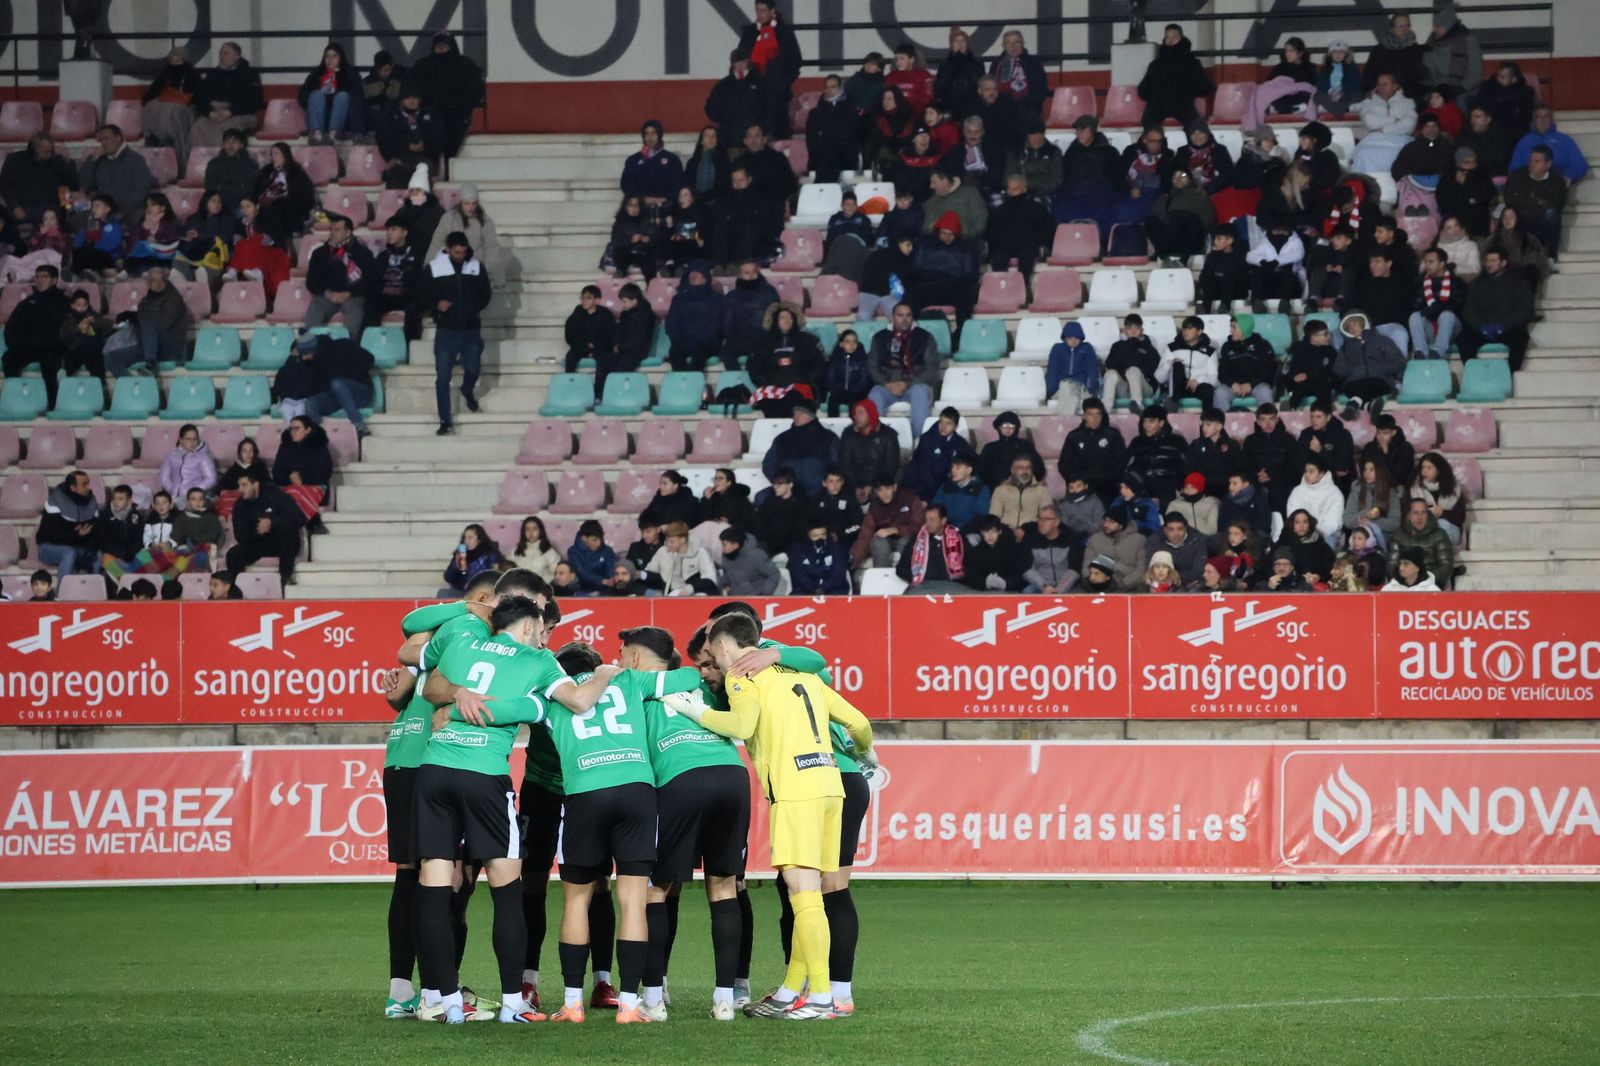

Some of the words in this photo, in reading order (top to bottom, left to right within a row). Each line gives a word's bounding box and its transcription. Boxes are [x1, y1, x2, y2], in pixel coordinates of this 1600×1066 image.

[0, 0, 211, 81] IO
[1398, 610, 1531, 631] DESGUACES
[102, 628, 133, 649] sgc
[323, 626, 354, 648] sgc
[573, 624, 605, 646] sgc
[795, 623, 827, 645] sgc
[1047, 622, 1080, 643] sgc
[1276, 621, 1309, 643] sgc
[480, 641, 517, 657] LUENGO
[1399, 636, 1600, 682] autorec
[0, 662, 169, 706] ngregorio
[194, 660, 386, 704] sangregorio
[916, 657, 1117, 700] sangregorio
[1142, 656, 1347, 700] sangregorio
[1401, 686, 1483, 701] RECICLADO
[1487, 686, 1506, 701] DE
[1511, 683, 1594, 701] VEHÍCULOS
[19, 710, 122, 719] CONSTRUCCION
[241, 708, 343, 716] CONSTRUCCION
[571, 685, 633, 740] 22
[791, 683, 822, 744] 1
[964, 704, 1069, 713] CONSTRUCCION
[1191, 704, 1298, 713] CONSTRUCCION
[581, 752, 642, 766] leomotor.net
[4, 781, 234, 830] ÁLVAREZ
[1396, 786, 1600, 836] INNOVA
[888, 804, 1248, 849] casqueriasusi.es
[85, 828, 231, 854] METÁLICAS
